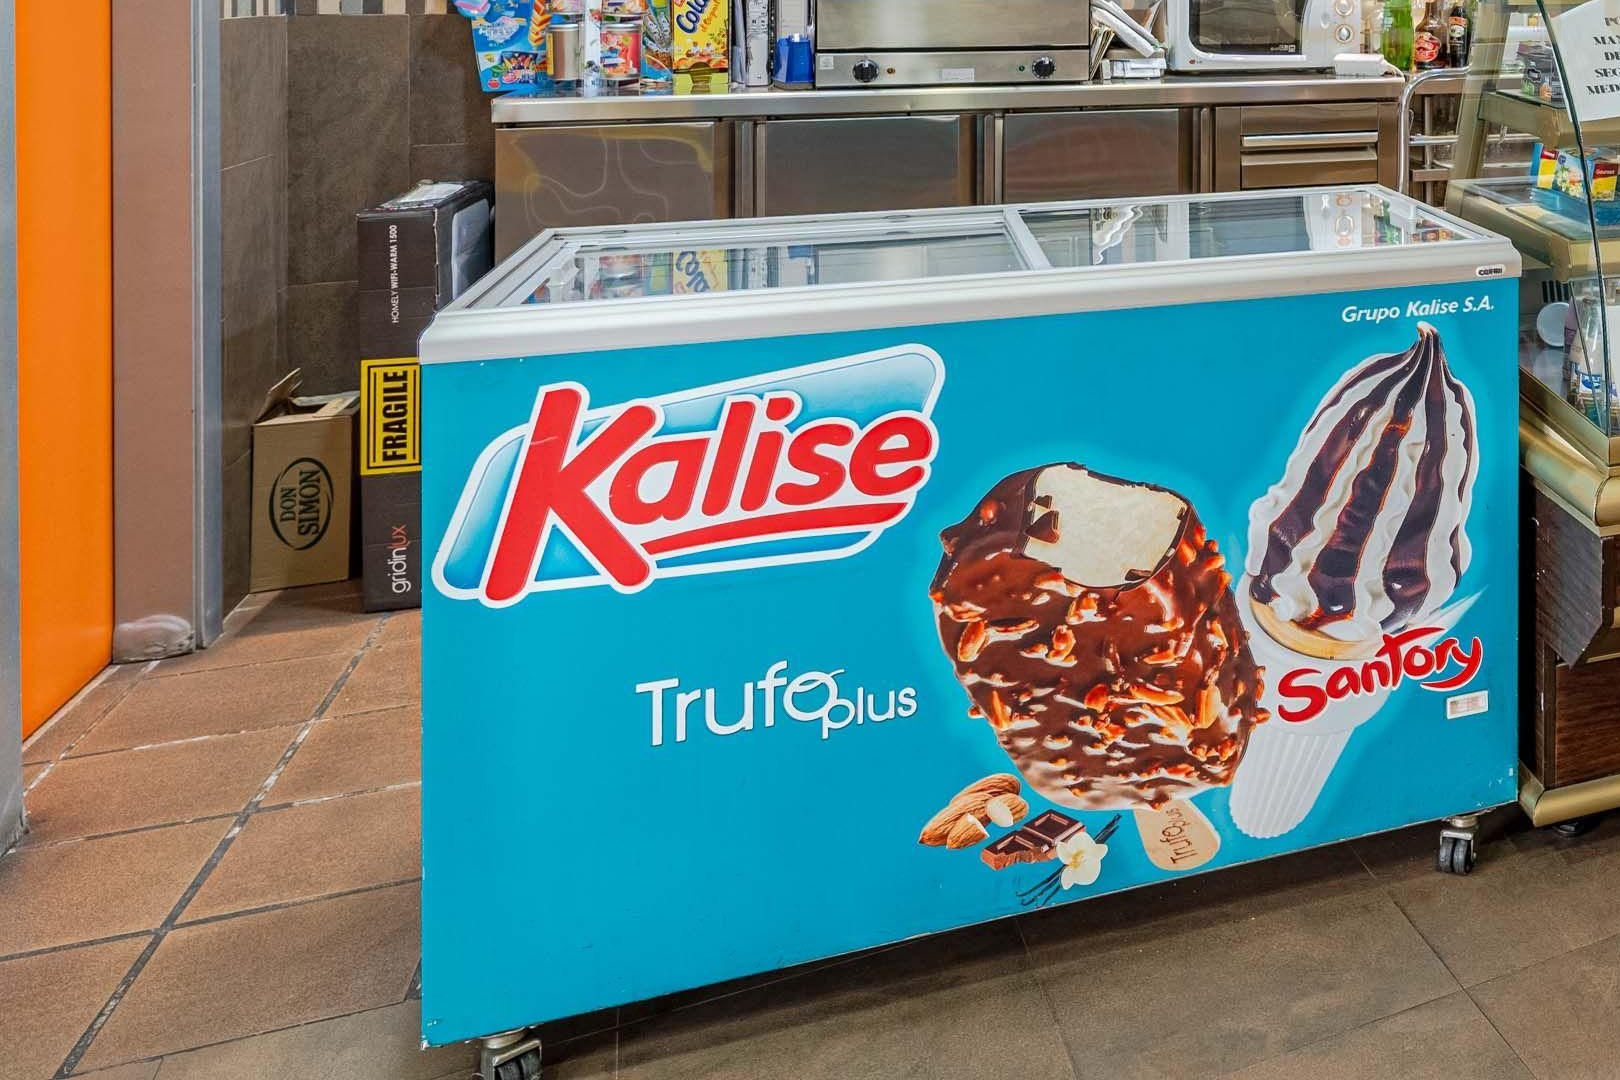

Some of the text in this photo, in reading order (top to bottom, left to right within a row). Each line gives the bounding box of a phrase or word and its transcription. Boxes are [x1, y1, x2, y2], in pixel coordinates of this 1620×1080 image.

[389, 225, 400, 324] HOMELY WIFI-WARM 1500
[1341, 295, 1495, 324] Grupo Kalise S.A.
[381, 367, 408, 463] FRAGILE
[280, 488, 296, 521] DON
[482, 381, 936, 607] Kalise
[388, 524, 411, 593] gridinlux
[1276, 624, 1485, 724] Santory
